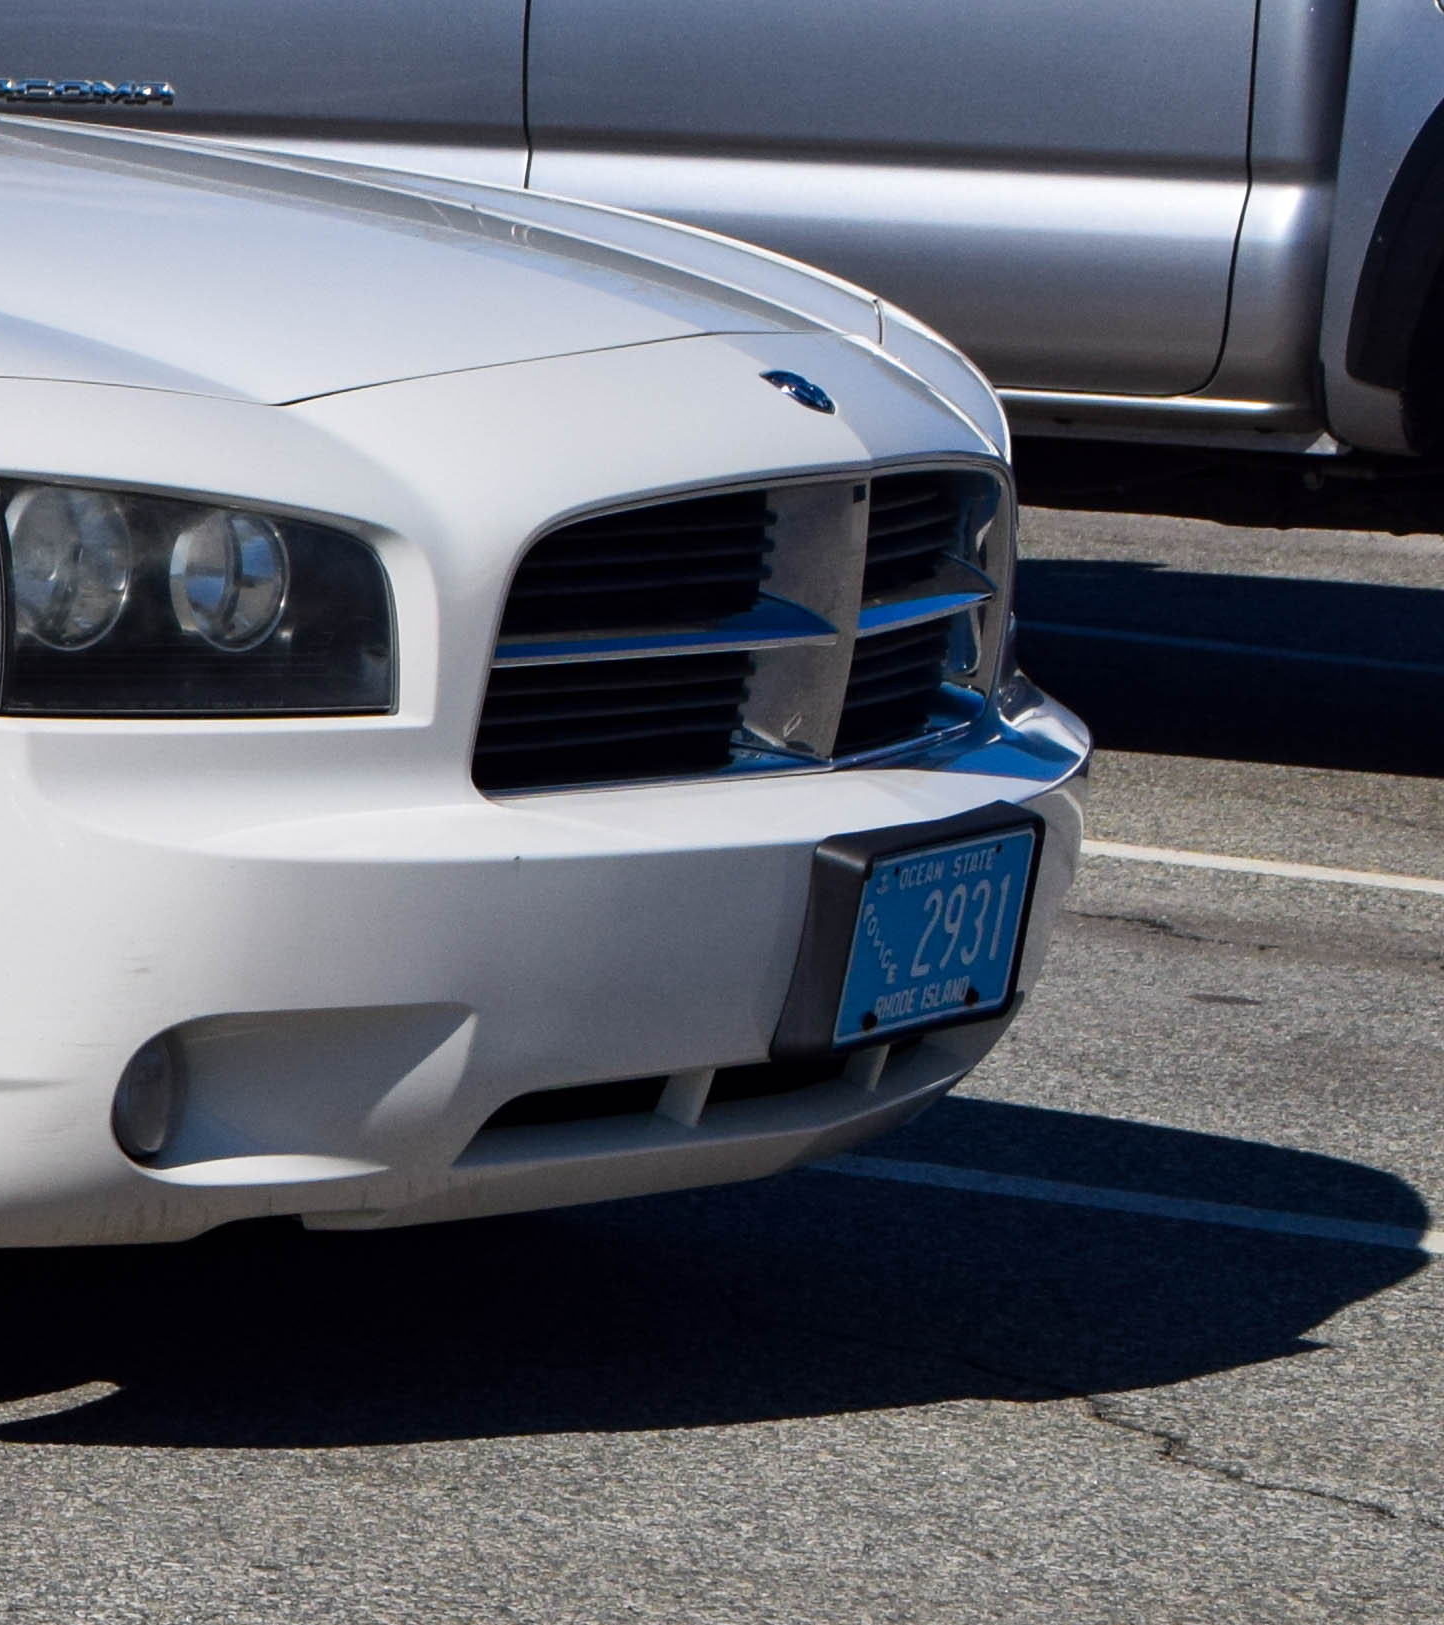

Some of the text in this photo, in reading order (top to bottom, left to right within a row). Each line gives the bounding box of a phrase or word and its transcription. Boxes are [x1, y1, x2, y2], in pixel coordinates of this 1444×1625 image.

[899, 848, 996, 890] OCEAN STATE
[862, 904, 898, 985] POLICE
[910, 874, 1011, 978] 2931
[874, 976, 970, 1019] RHODE ISLAND
